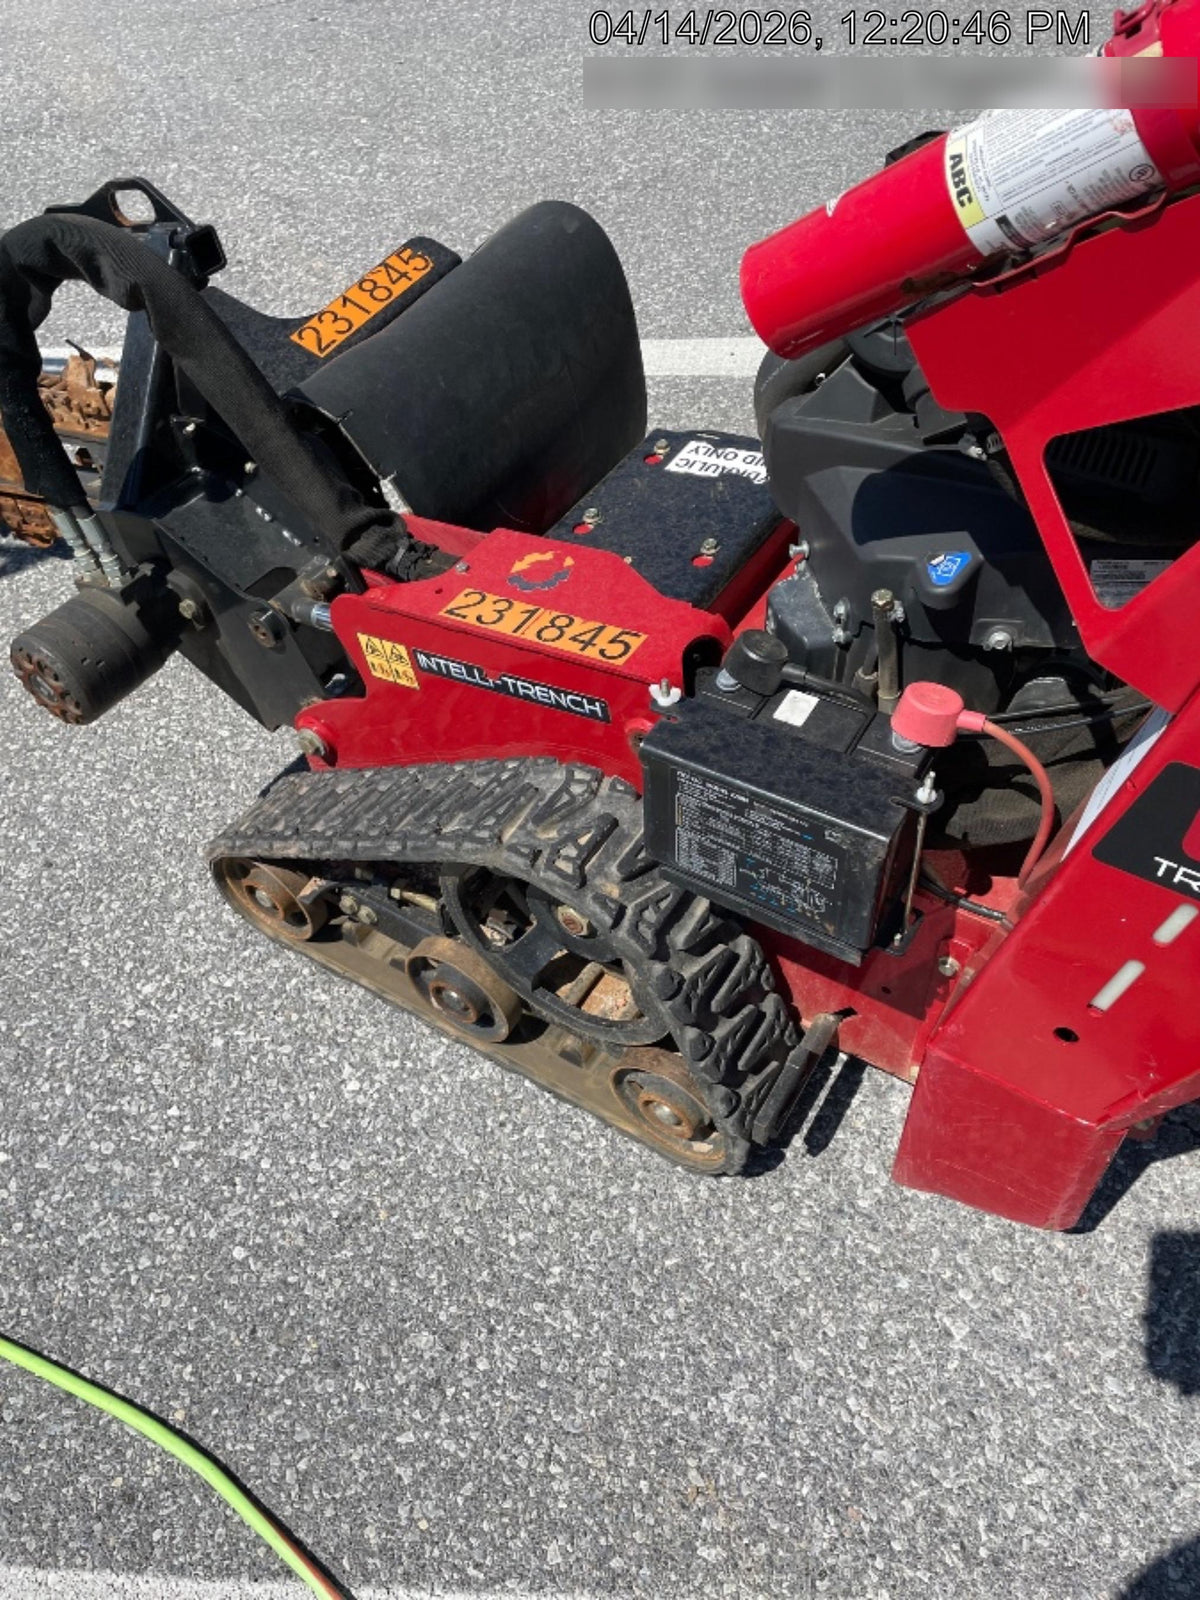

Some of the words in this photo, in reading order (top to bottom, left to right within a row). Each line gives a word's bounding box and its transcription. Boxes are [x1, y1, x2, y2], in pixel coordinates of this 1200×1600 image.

[949, 152, 974, 208] ABC
[297, 246, 432, 354] 231845
[687, 445, 739, 461] ONLY
[444, 590, 642, 661] 231845
